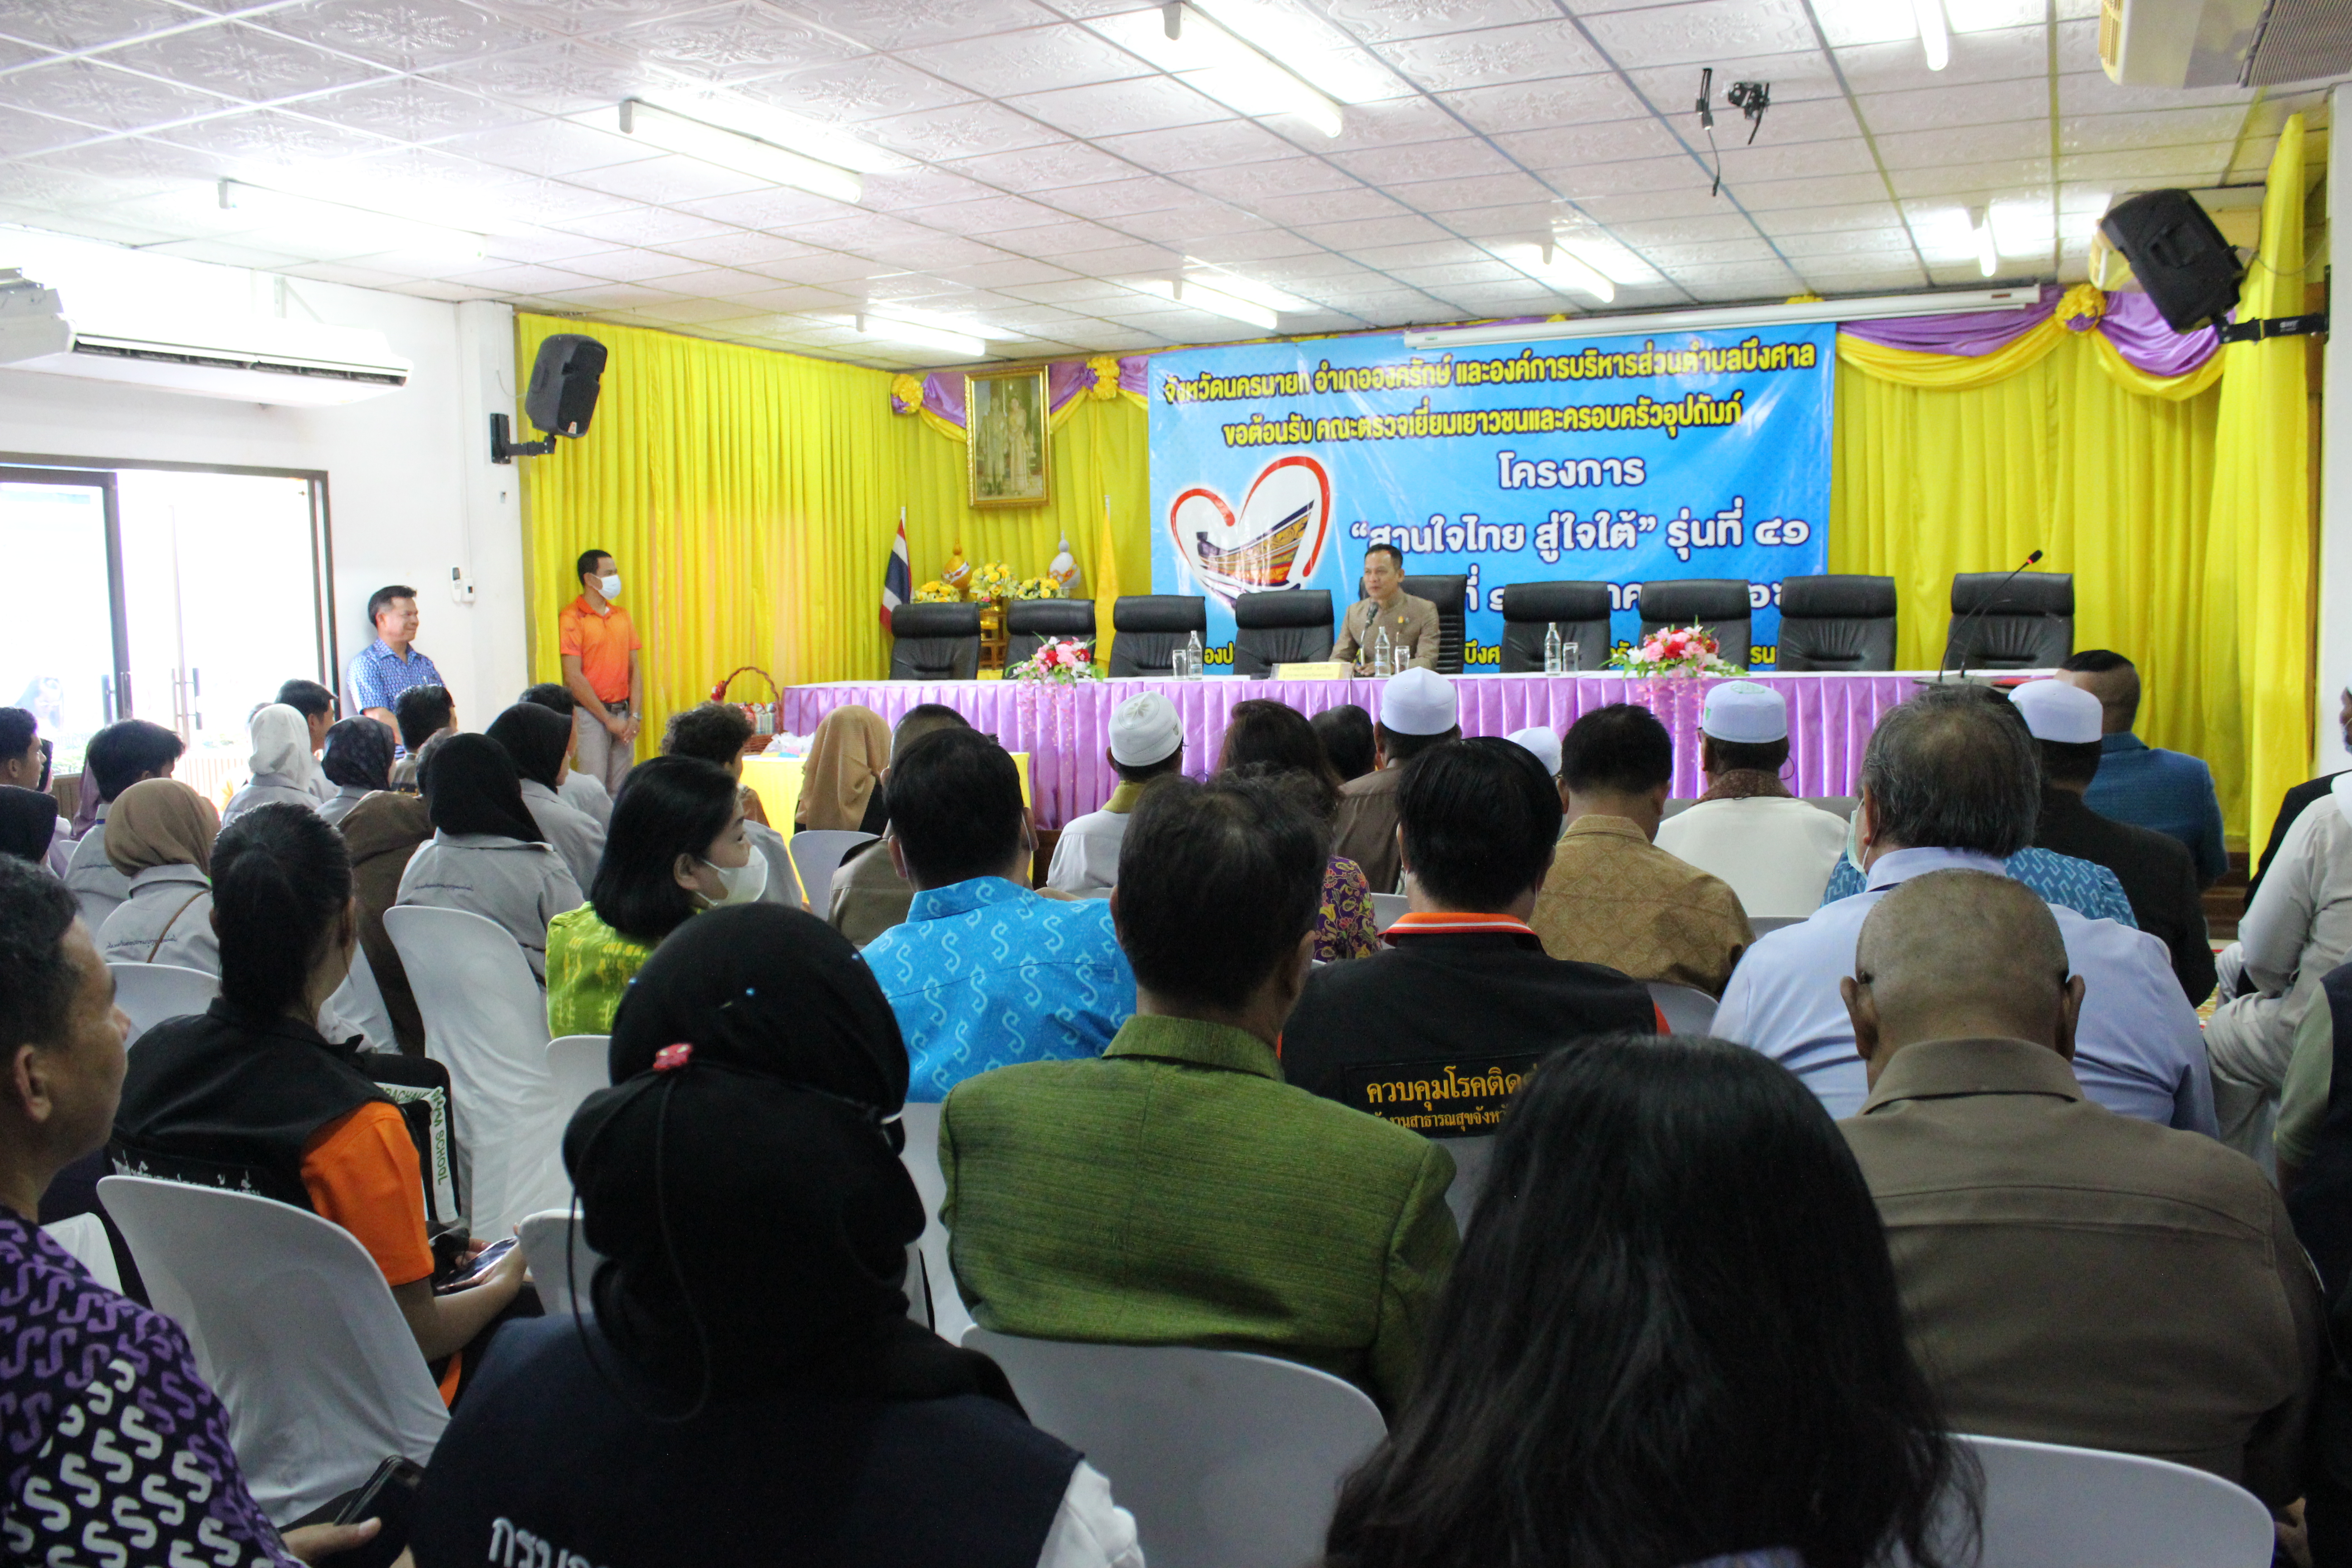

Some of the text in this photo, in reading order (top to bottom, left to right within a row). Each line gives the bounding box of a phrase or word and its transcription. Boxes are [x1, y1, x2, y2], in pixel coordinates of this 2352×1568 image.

[1164, 337, 1816, 405] จังหวัดนครนายก อำเภอองครักษ์ และองค์การบริหารส่วนตำบลบึงศาล
[1223, 390, 1744, 446] ขอต้อนรับ คณะตรวจเยี่ยมเยาวชนและครอบครัวอุปถัมภ์
[1497, 450, 1646, 489] โครงการ
[1666, 496, 1744, 563] รุ่นที่
[1753, 516, 1810, 547] ๔๑
[436, 1130, 448, 1186] SCHOOL
